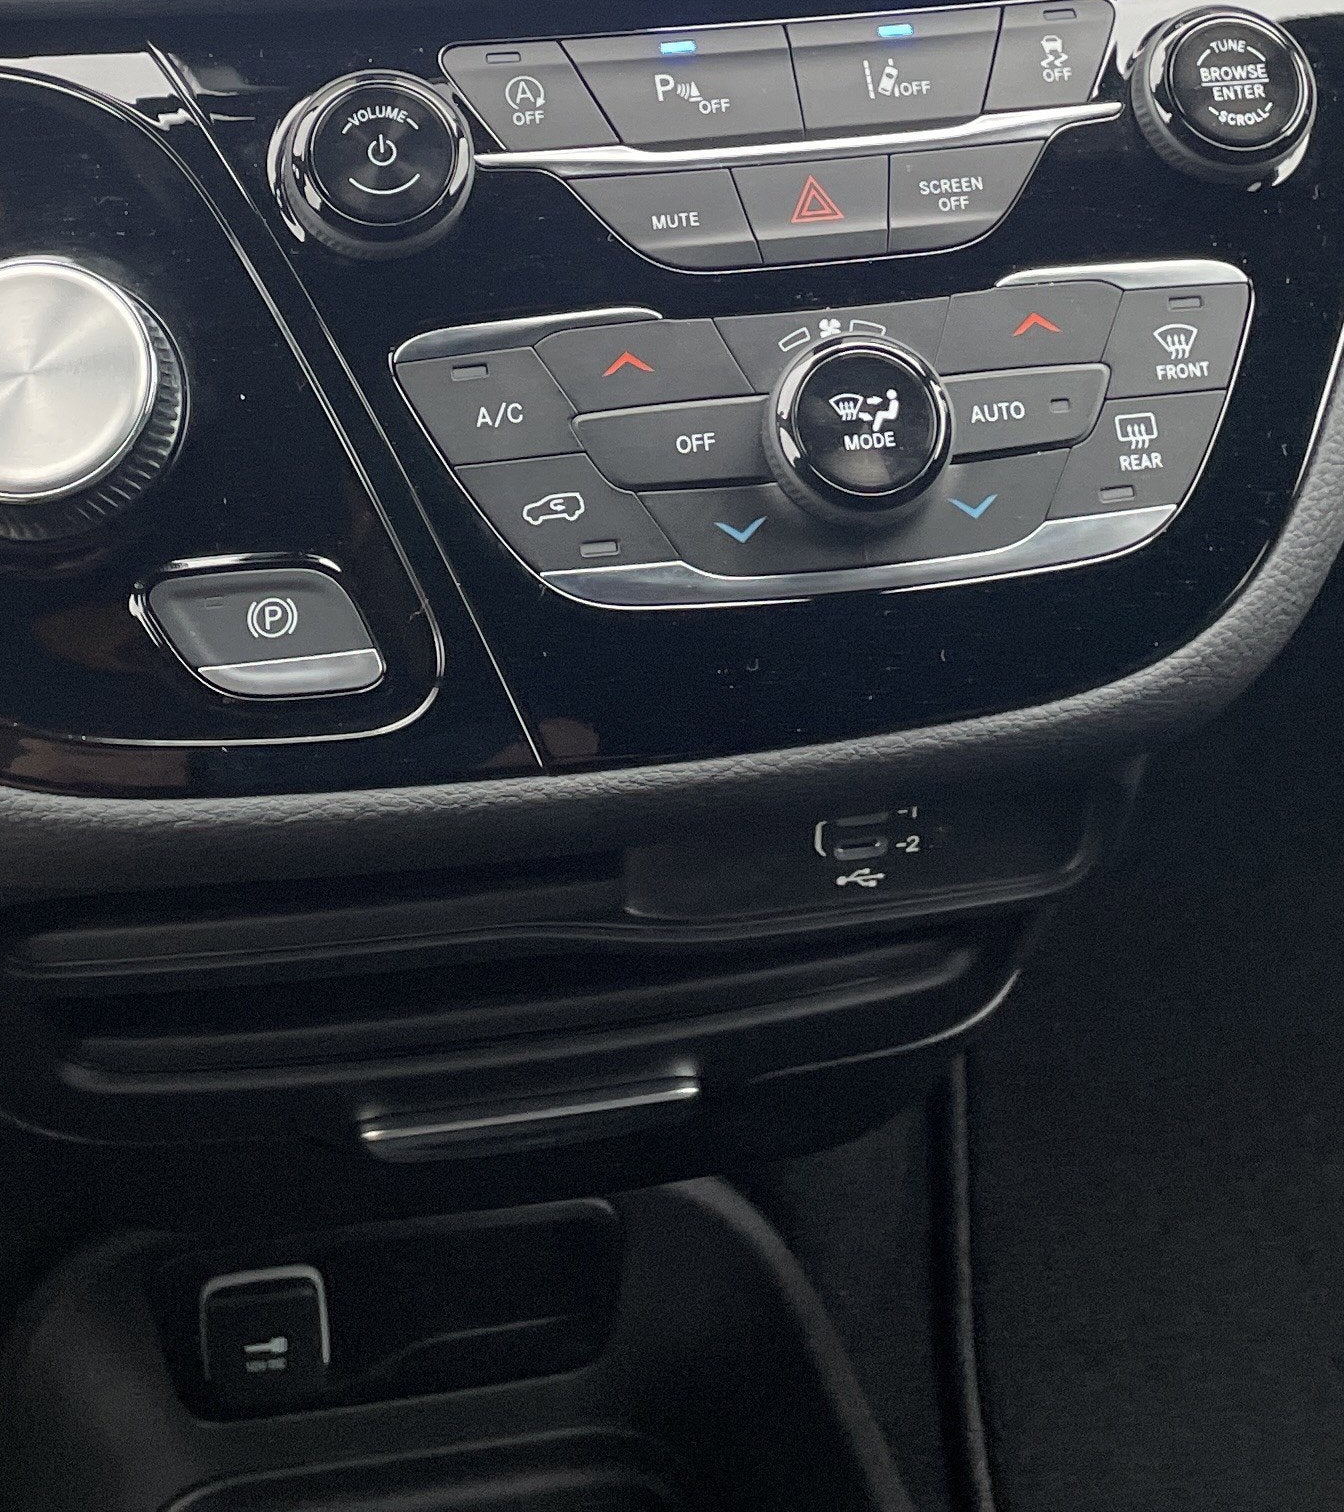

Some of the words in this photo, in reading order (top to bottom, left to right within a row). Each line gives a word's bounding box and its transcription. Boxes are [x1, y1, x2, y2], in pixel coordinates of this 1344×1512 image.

[1209, 38, 1247, 56] TUNE
[1042, 66, 1073, 84] OFF
[1199, 62, 1270, 84] BROWSE
[900, 79, 932, 97] OFF
[1211, 83, 1267, 103] ENTER
[346, 104, 409, 128] VOLUME
[698, 98, 731, 116] OFF
[512, 109, 545, 127] OFF
[1217, 107, 1270, 128] SCROLL
[919, 175, 984, 196] SCREEN
[938, 195, 970, 212] OFF
[652, 211, 701, 230] MUTE
[1155, 360, 1211, 381] FRONT
[476, 402, 524, 429] A/C
[970, 400, 1026, 425] AUTO
[675, 432, 717, 455] OFF
[843, 431, 897, 452] MODE
[1118, 452, 1164, 472] REAR
